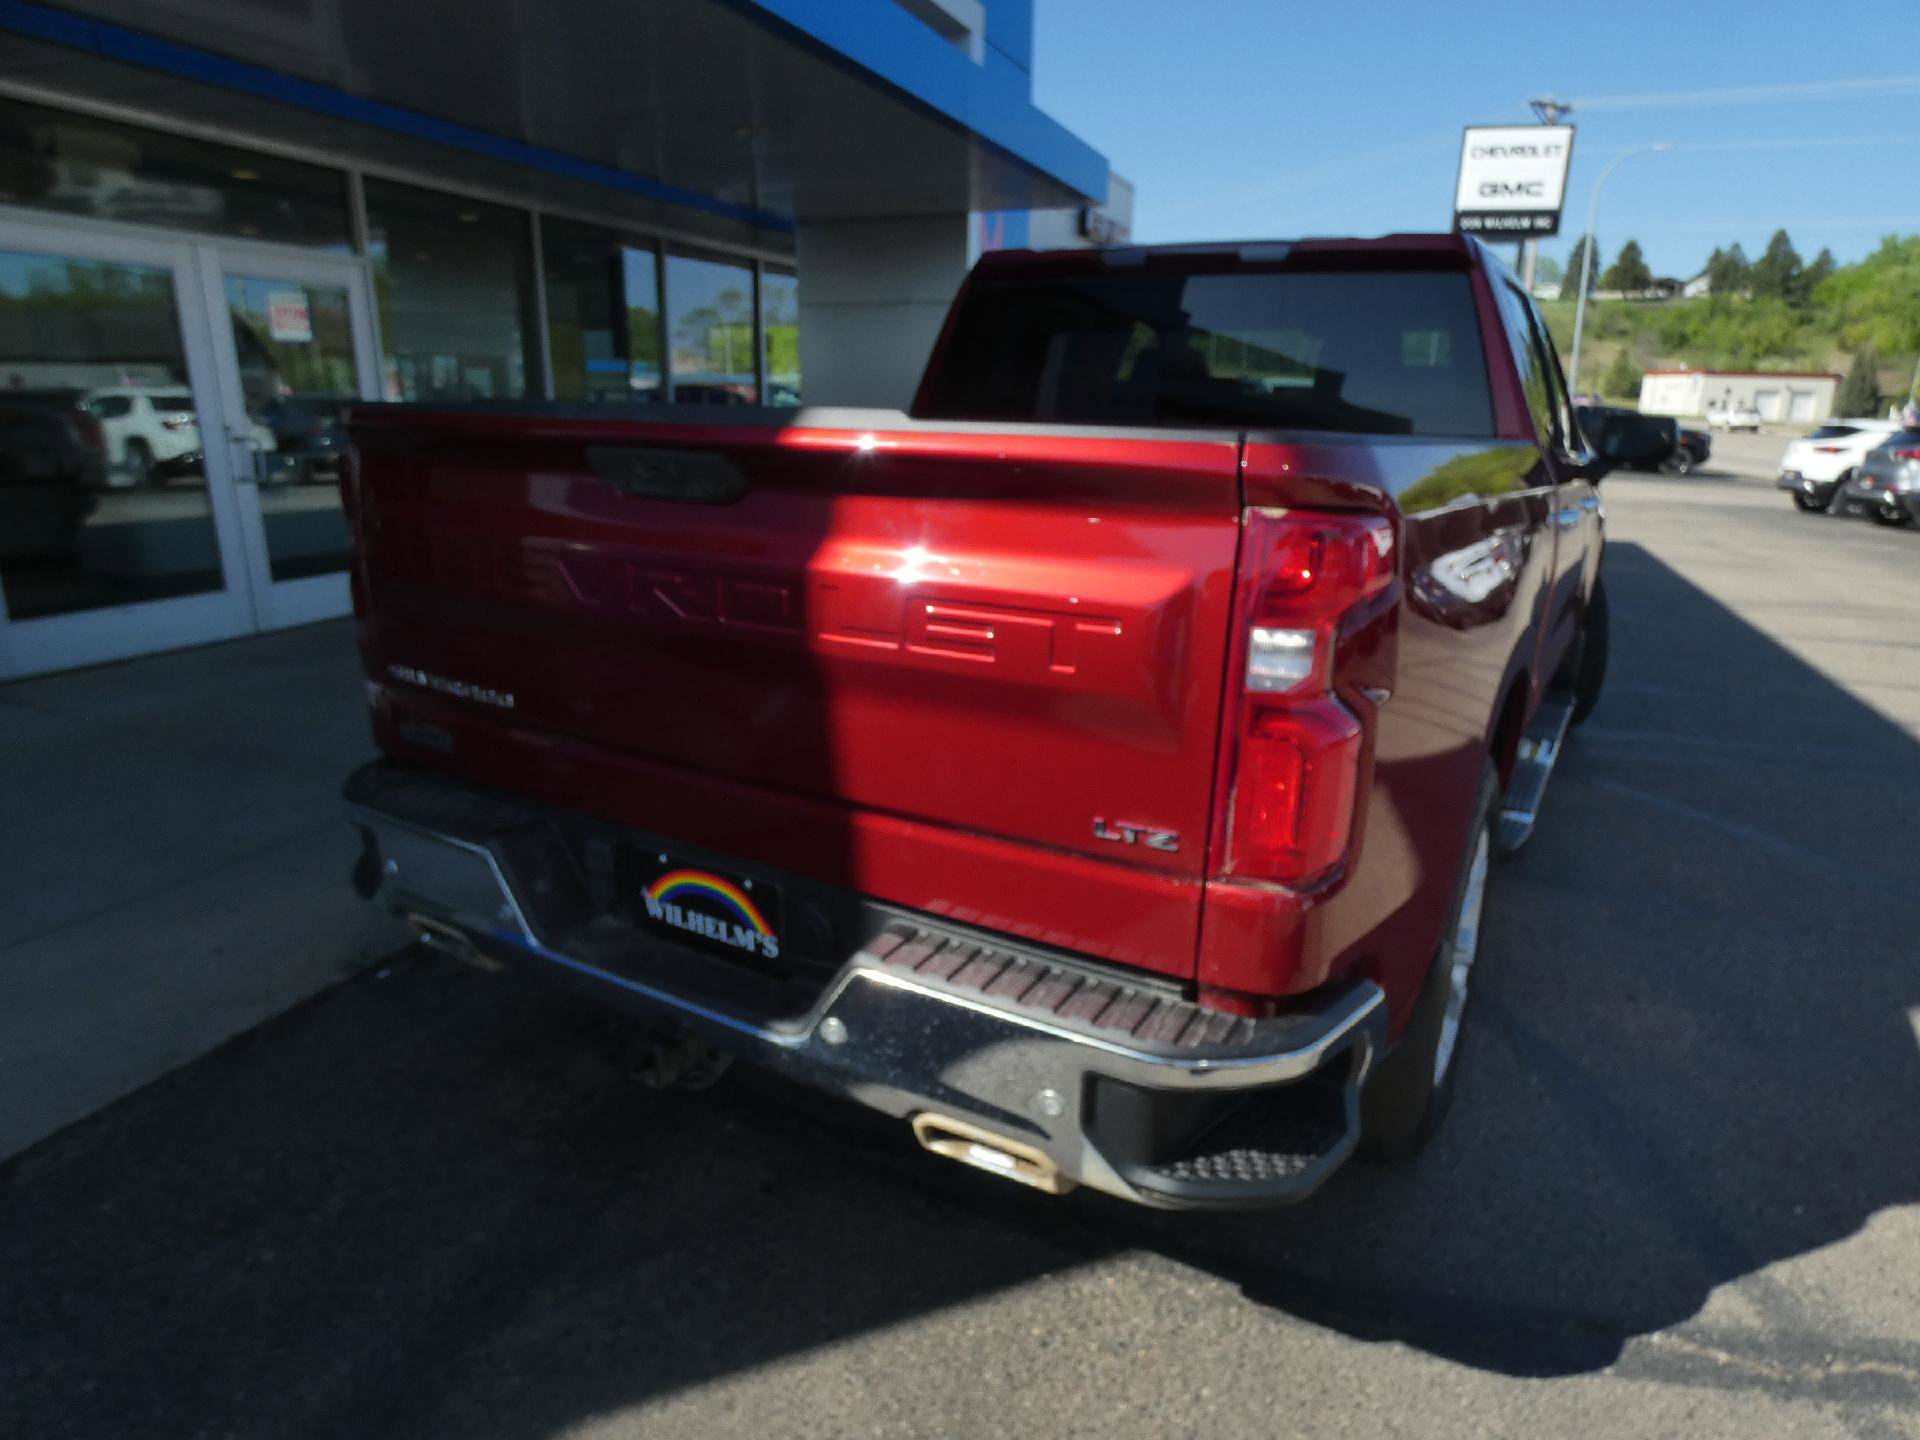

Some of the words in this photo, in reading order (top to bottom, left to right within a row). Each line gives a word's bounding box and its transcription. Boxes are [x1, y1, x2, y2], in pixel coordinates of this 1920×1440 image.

[1472, 145, 1562, 159] CHEVROLET
[1479, 182, 1544, 197] GMC
[1093, 816, 1180, 853] LTZ
[642, 889, 779, 959] WILHELM'S
